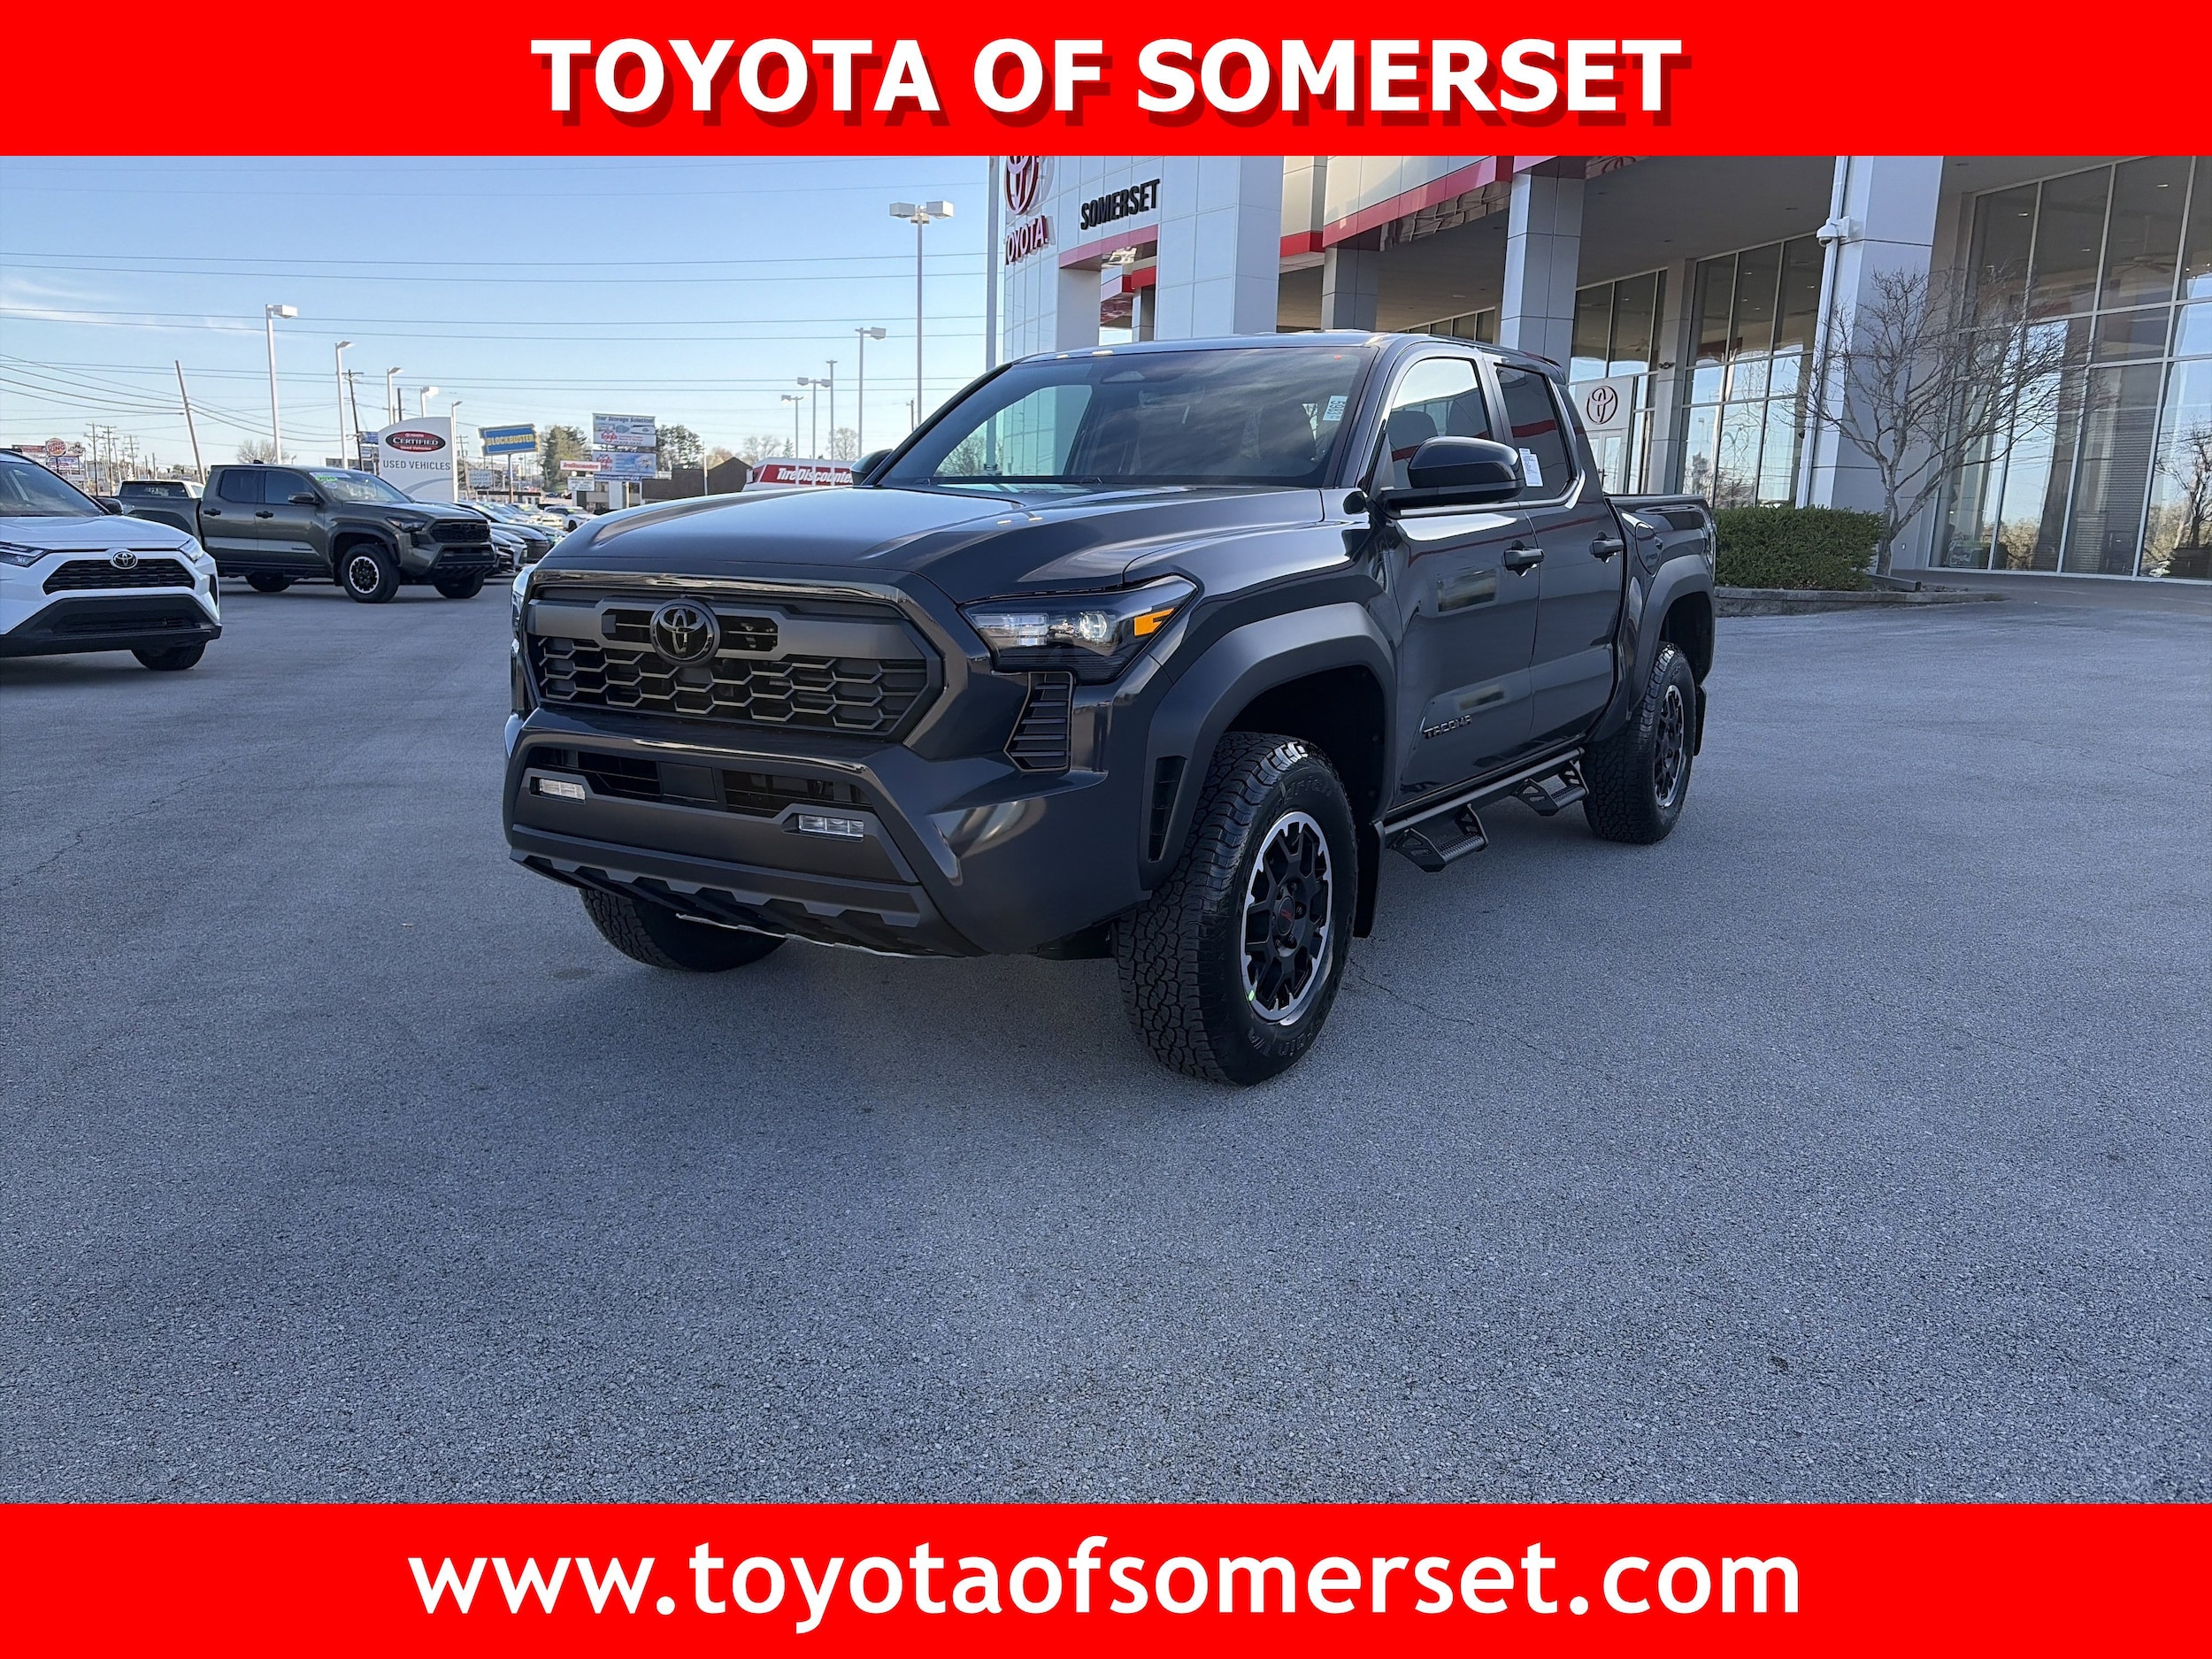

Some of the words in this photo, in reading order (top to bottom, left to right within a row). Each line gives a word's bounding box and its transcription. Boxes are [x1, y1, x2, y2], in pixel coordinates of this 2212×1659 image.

[1080, 179, 1161, 230] SOMERSET
[392, 437, 439, 446] CERTIFIED
[486, 434, 534, 446] BLOCKBUSTER
[383, 460, 407, 469] USED
[408, 461, 451, 471] VEHICLES
[1423, 714, 1471, 739] TACOMA
